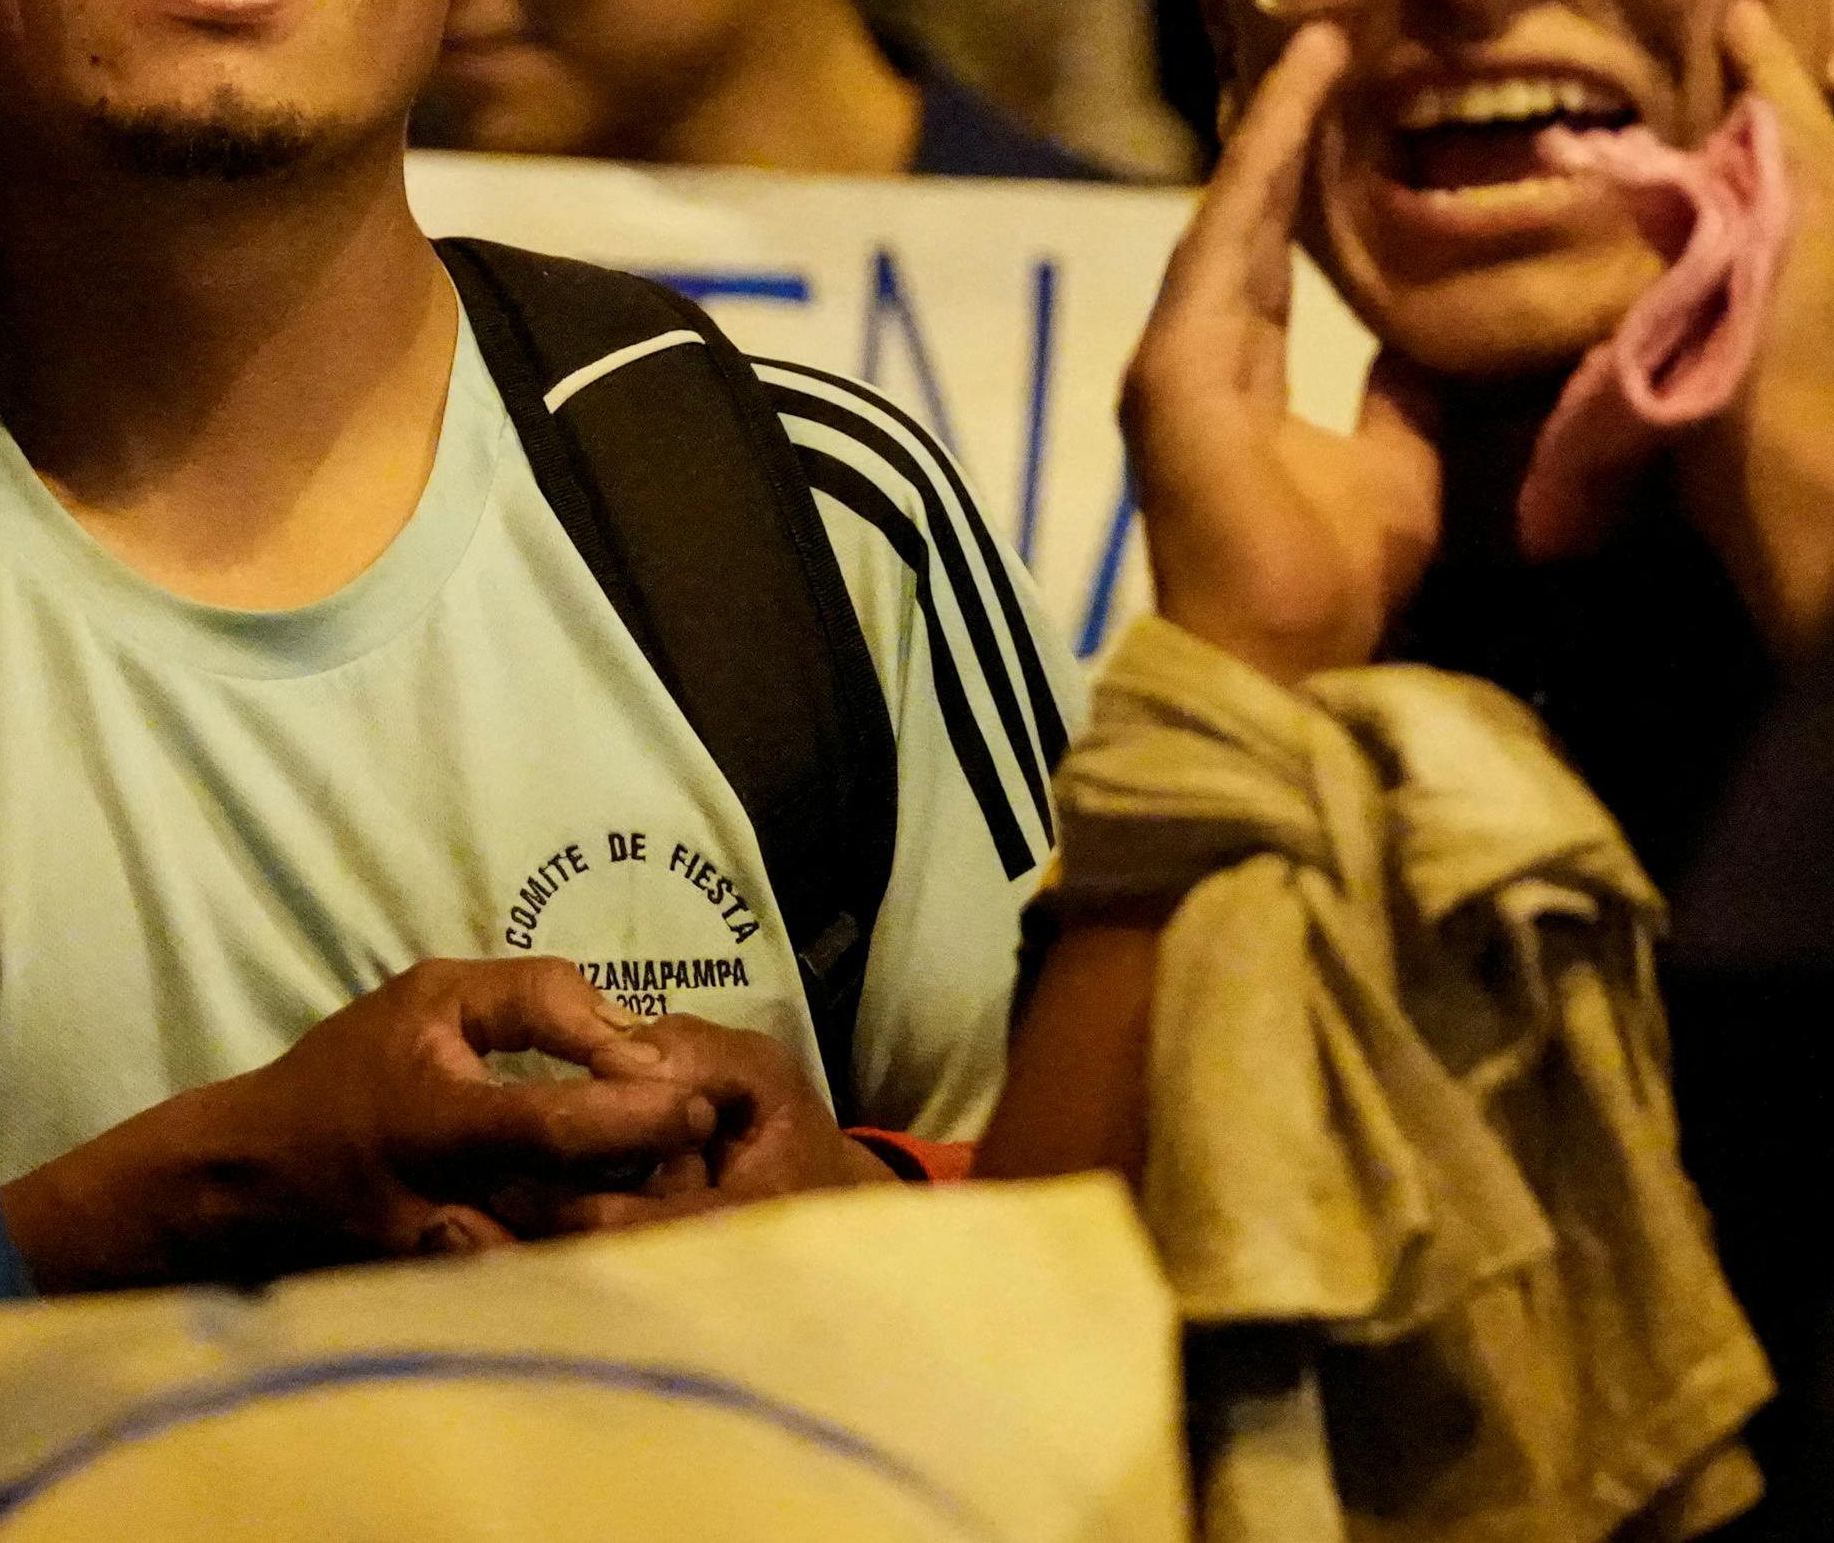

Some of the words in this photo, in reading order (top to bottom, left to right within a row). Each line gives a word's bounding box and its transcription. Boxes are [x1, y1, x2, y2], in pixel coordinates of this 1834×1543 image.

[505, 844, 590, 950] COMITE
[607, 832, 647, 863] DE
[669, 842, 761, 945] FIESTA
